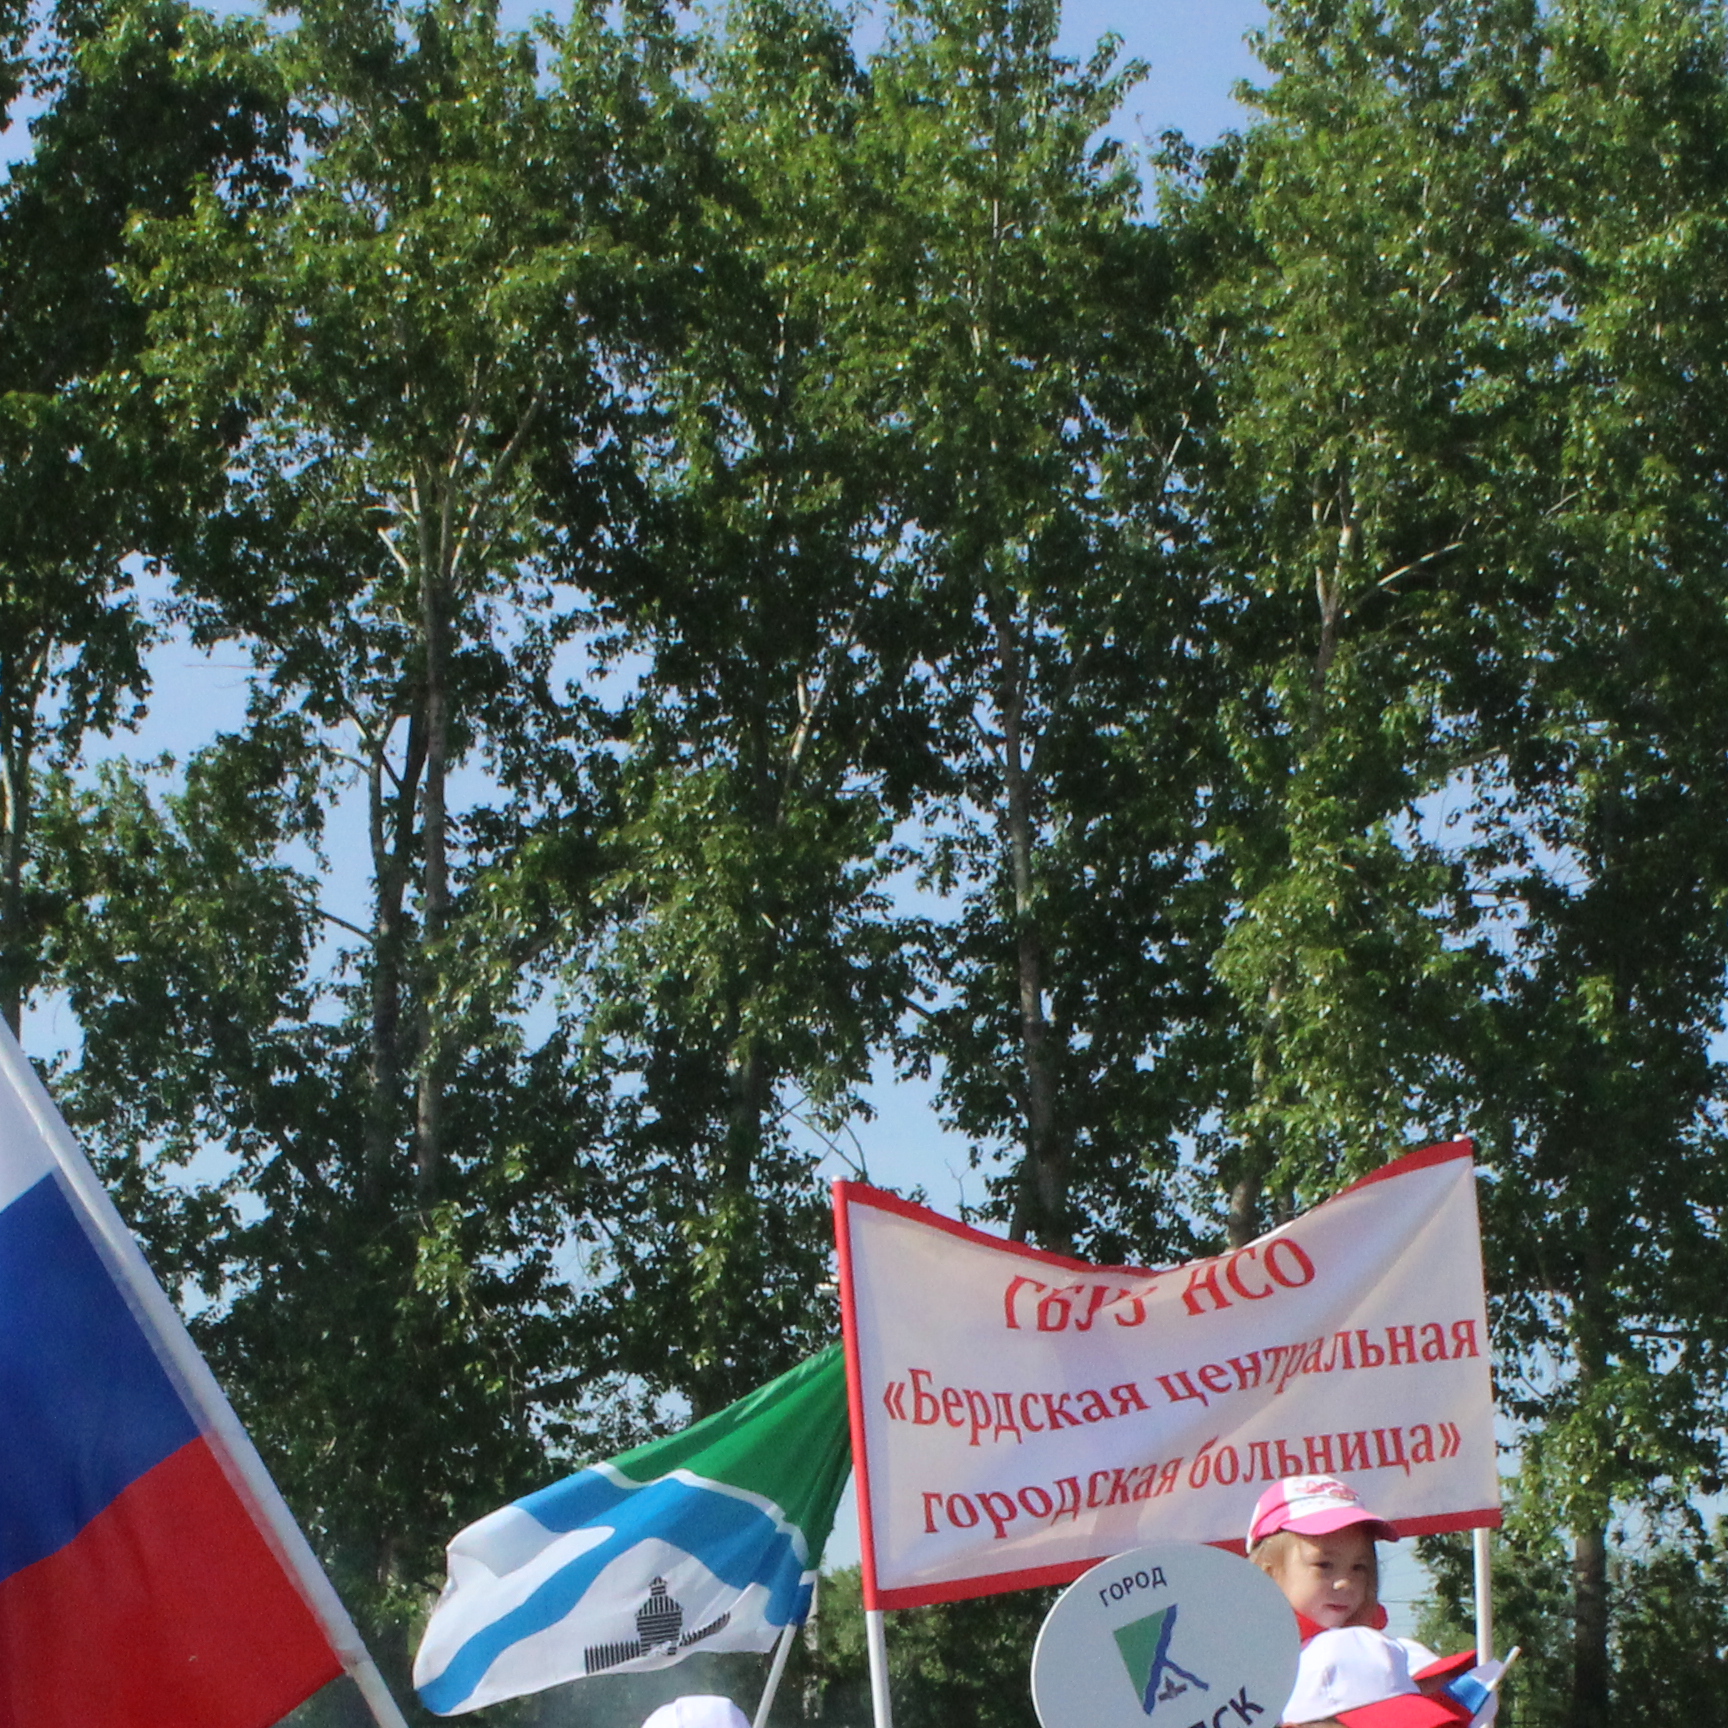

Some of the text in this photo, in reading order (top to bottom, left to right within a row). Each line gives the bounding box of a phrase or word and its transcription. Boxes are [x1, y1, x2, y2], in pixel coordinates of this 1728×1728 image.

[1181, 1237, 1315, 1316] НСО
[883, 1318, 1480, 1447] «Бердская центральная
[921, 1421, 1463, 1540] городская больница»
[1099, 1566, 1168, 1607] ГОРОД
